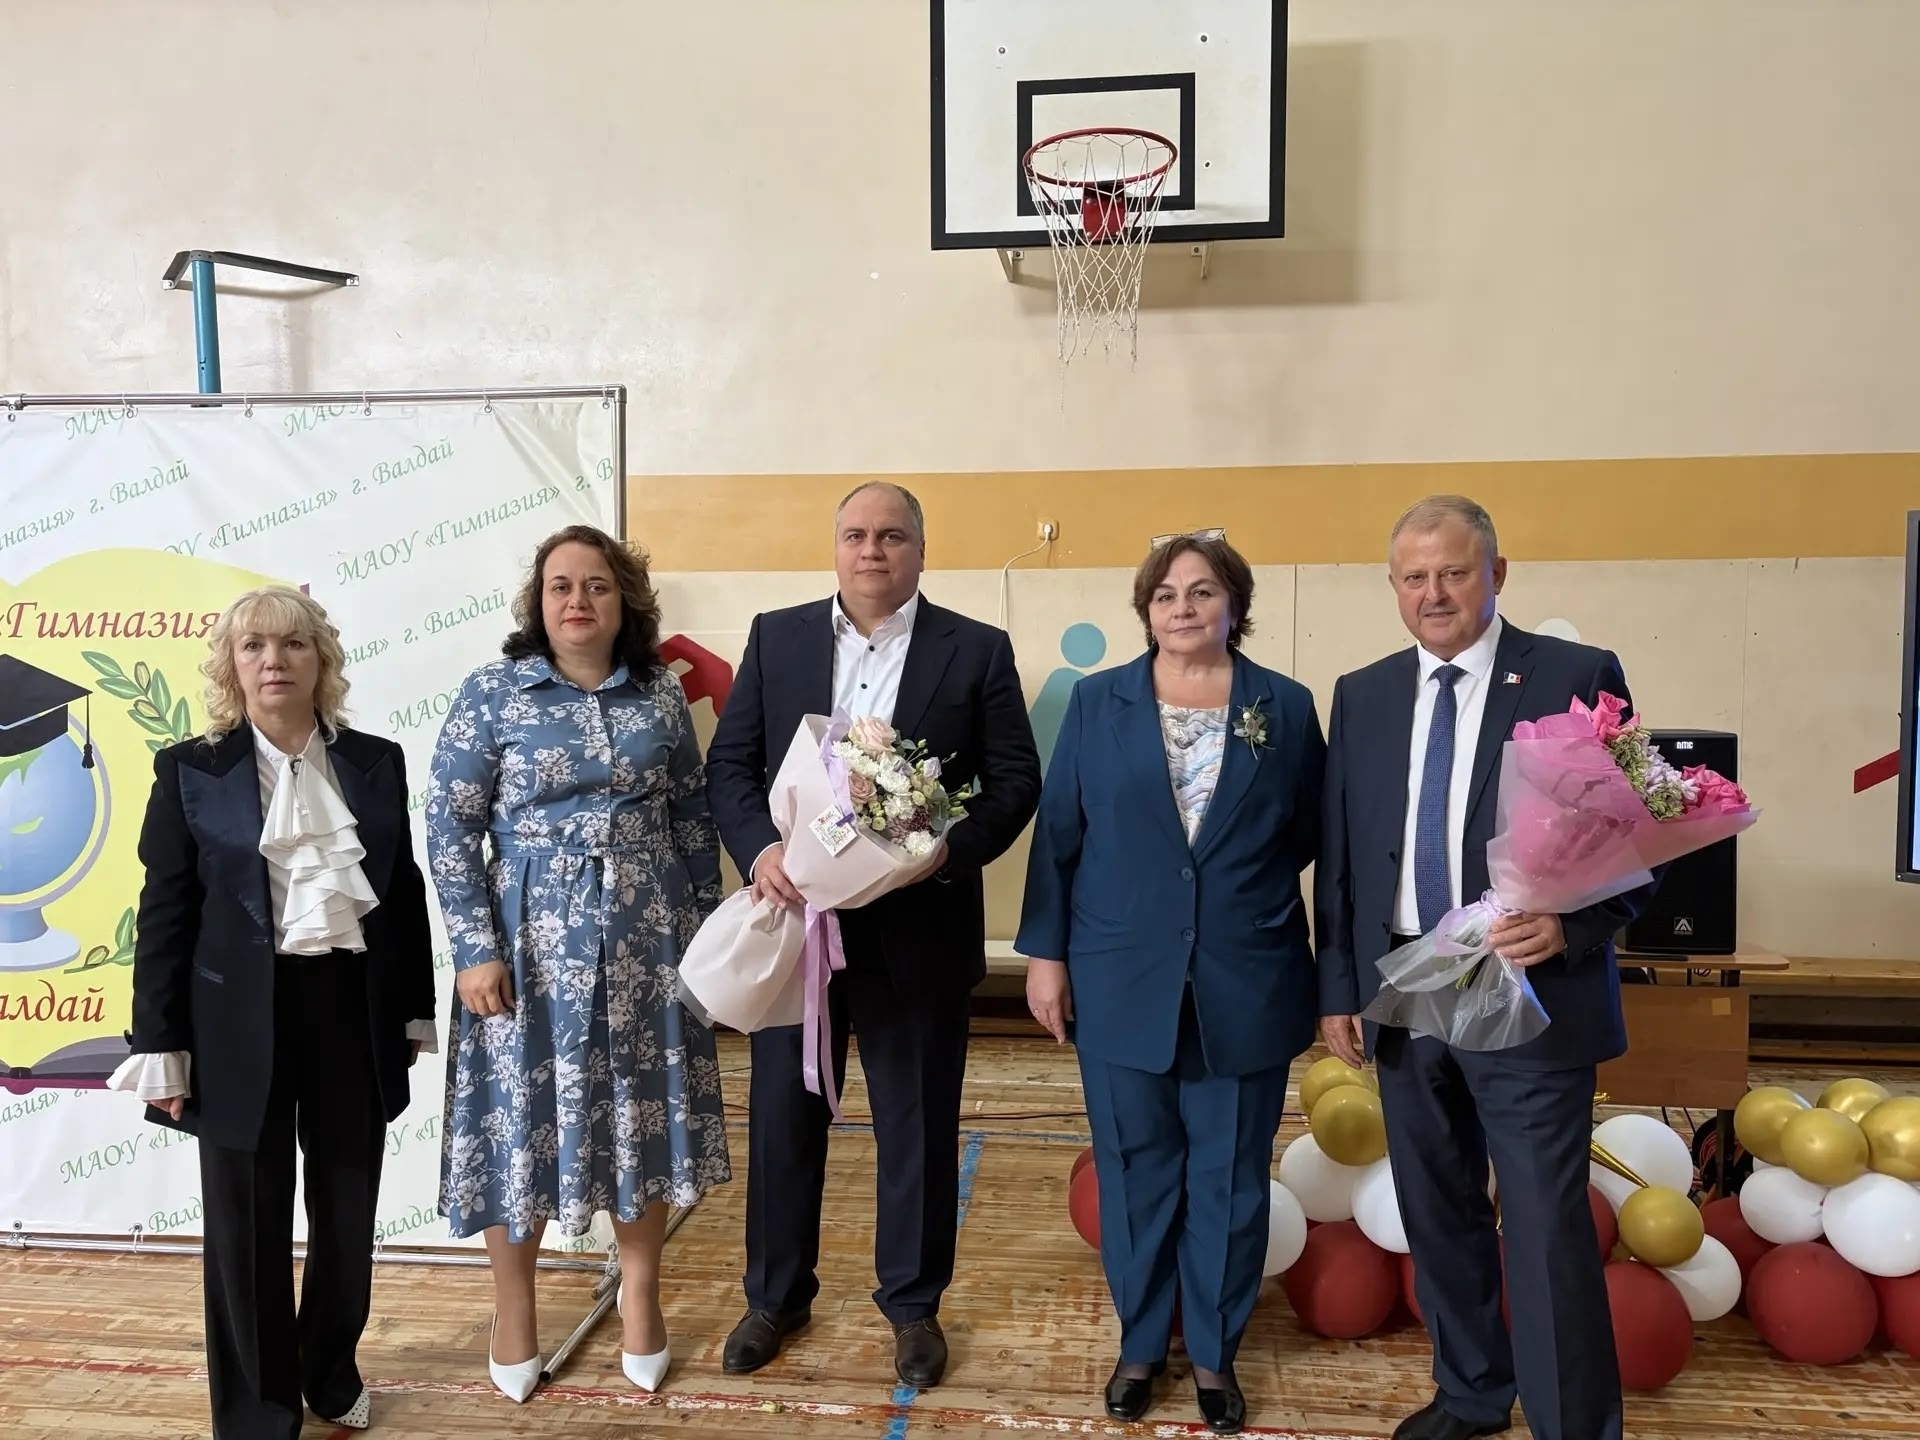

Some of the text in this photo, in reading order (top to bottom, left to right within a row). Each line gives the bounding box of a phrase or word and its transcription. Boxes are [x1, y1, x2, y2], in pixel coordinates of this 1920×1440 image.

[90, 498, 104, 515] г.
[109, 458, 190, 505] Валдай
[208, 489, 338, 550] «Гимназия»
[352, 478, 367, 495] г.
[371, 435, 454, 485] Валдай
[336, 530, 420, 586] МАОУ
[424, 485, 560, 549] «Гимназия»
[575, 474, 591, 492] г.
[404, 628, 418, 644] г.
[424, 587, 508, 635] Валдай
[60, 1133, 143, 1183] МАОУ
